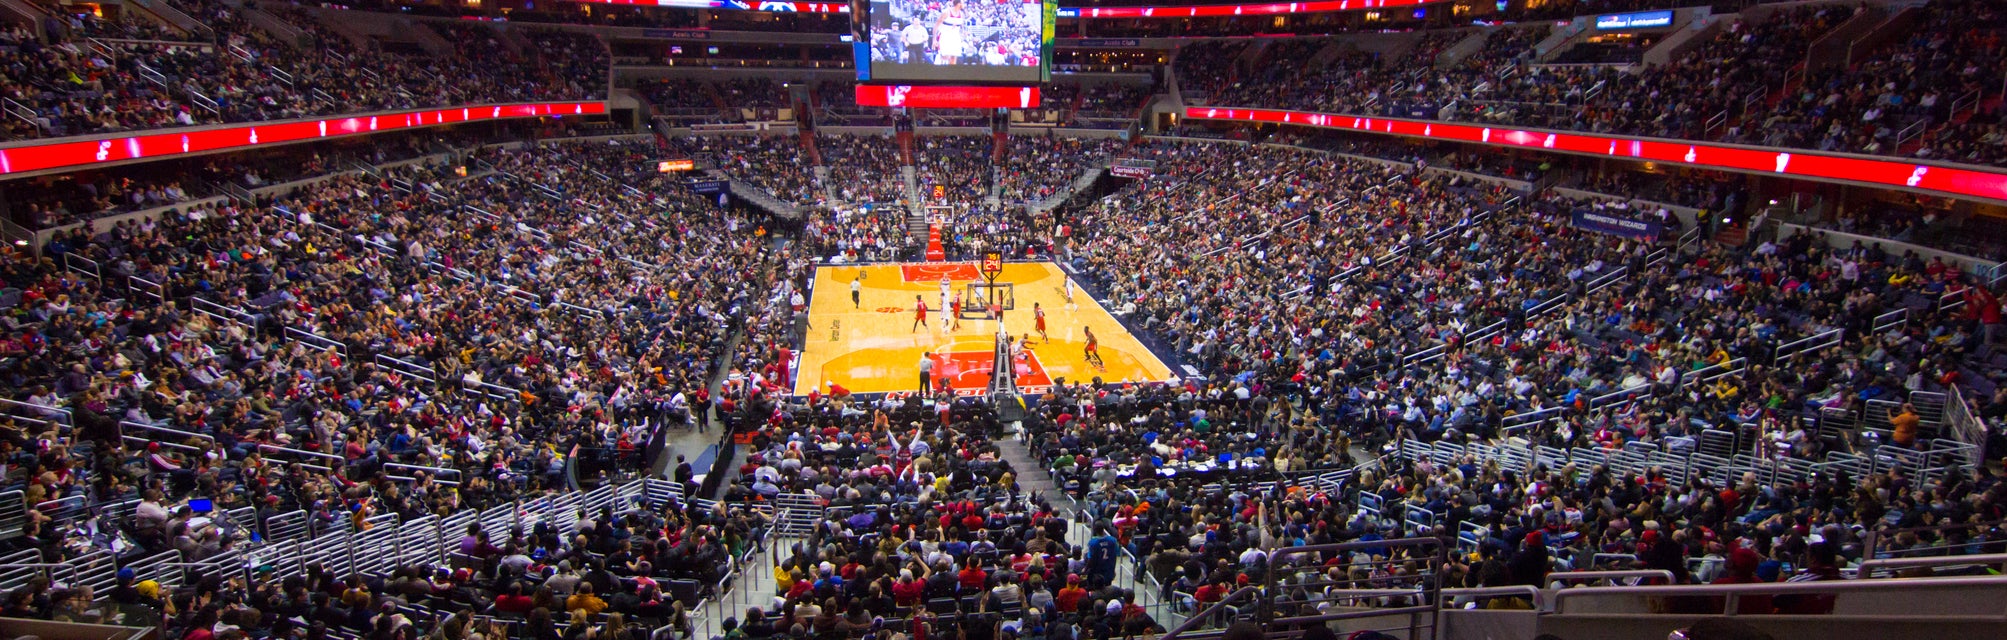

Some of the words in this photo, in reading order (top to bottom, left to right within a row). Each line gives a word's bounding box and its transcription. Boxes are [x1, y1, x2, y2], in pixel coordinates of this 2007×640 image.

[1584, 213, 1618, 224] WASHINGTON
[1619, 219, 1647, 230] WIZARDS
[985, 259, 998, 270] 24
[1101, 547, 1110, 560] 2
